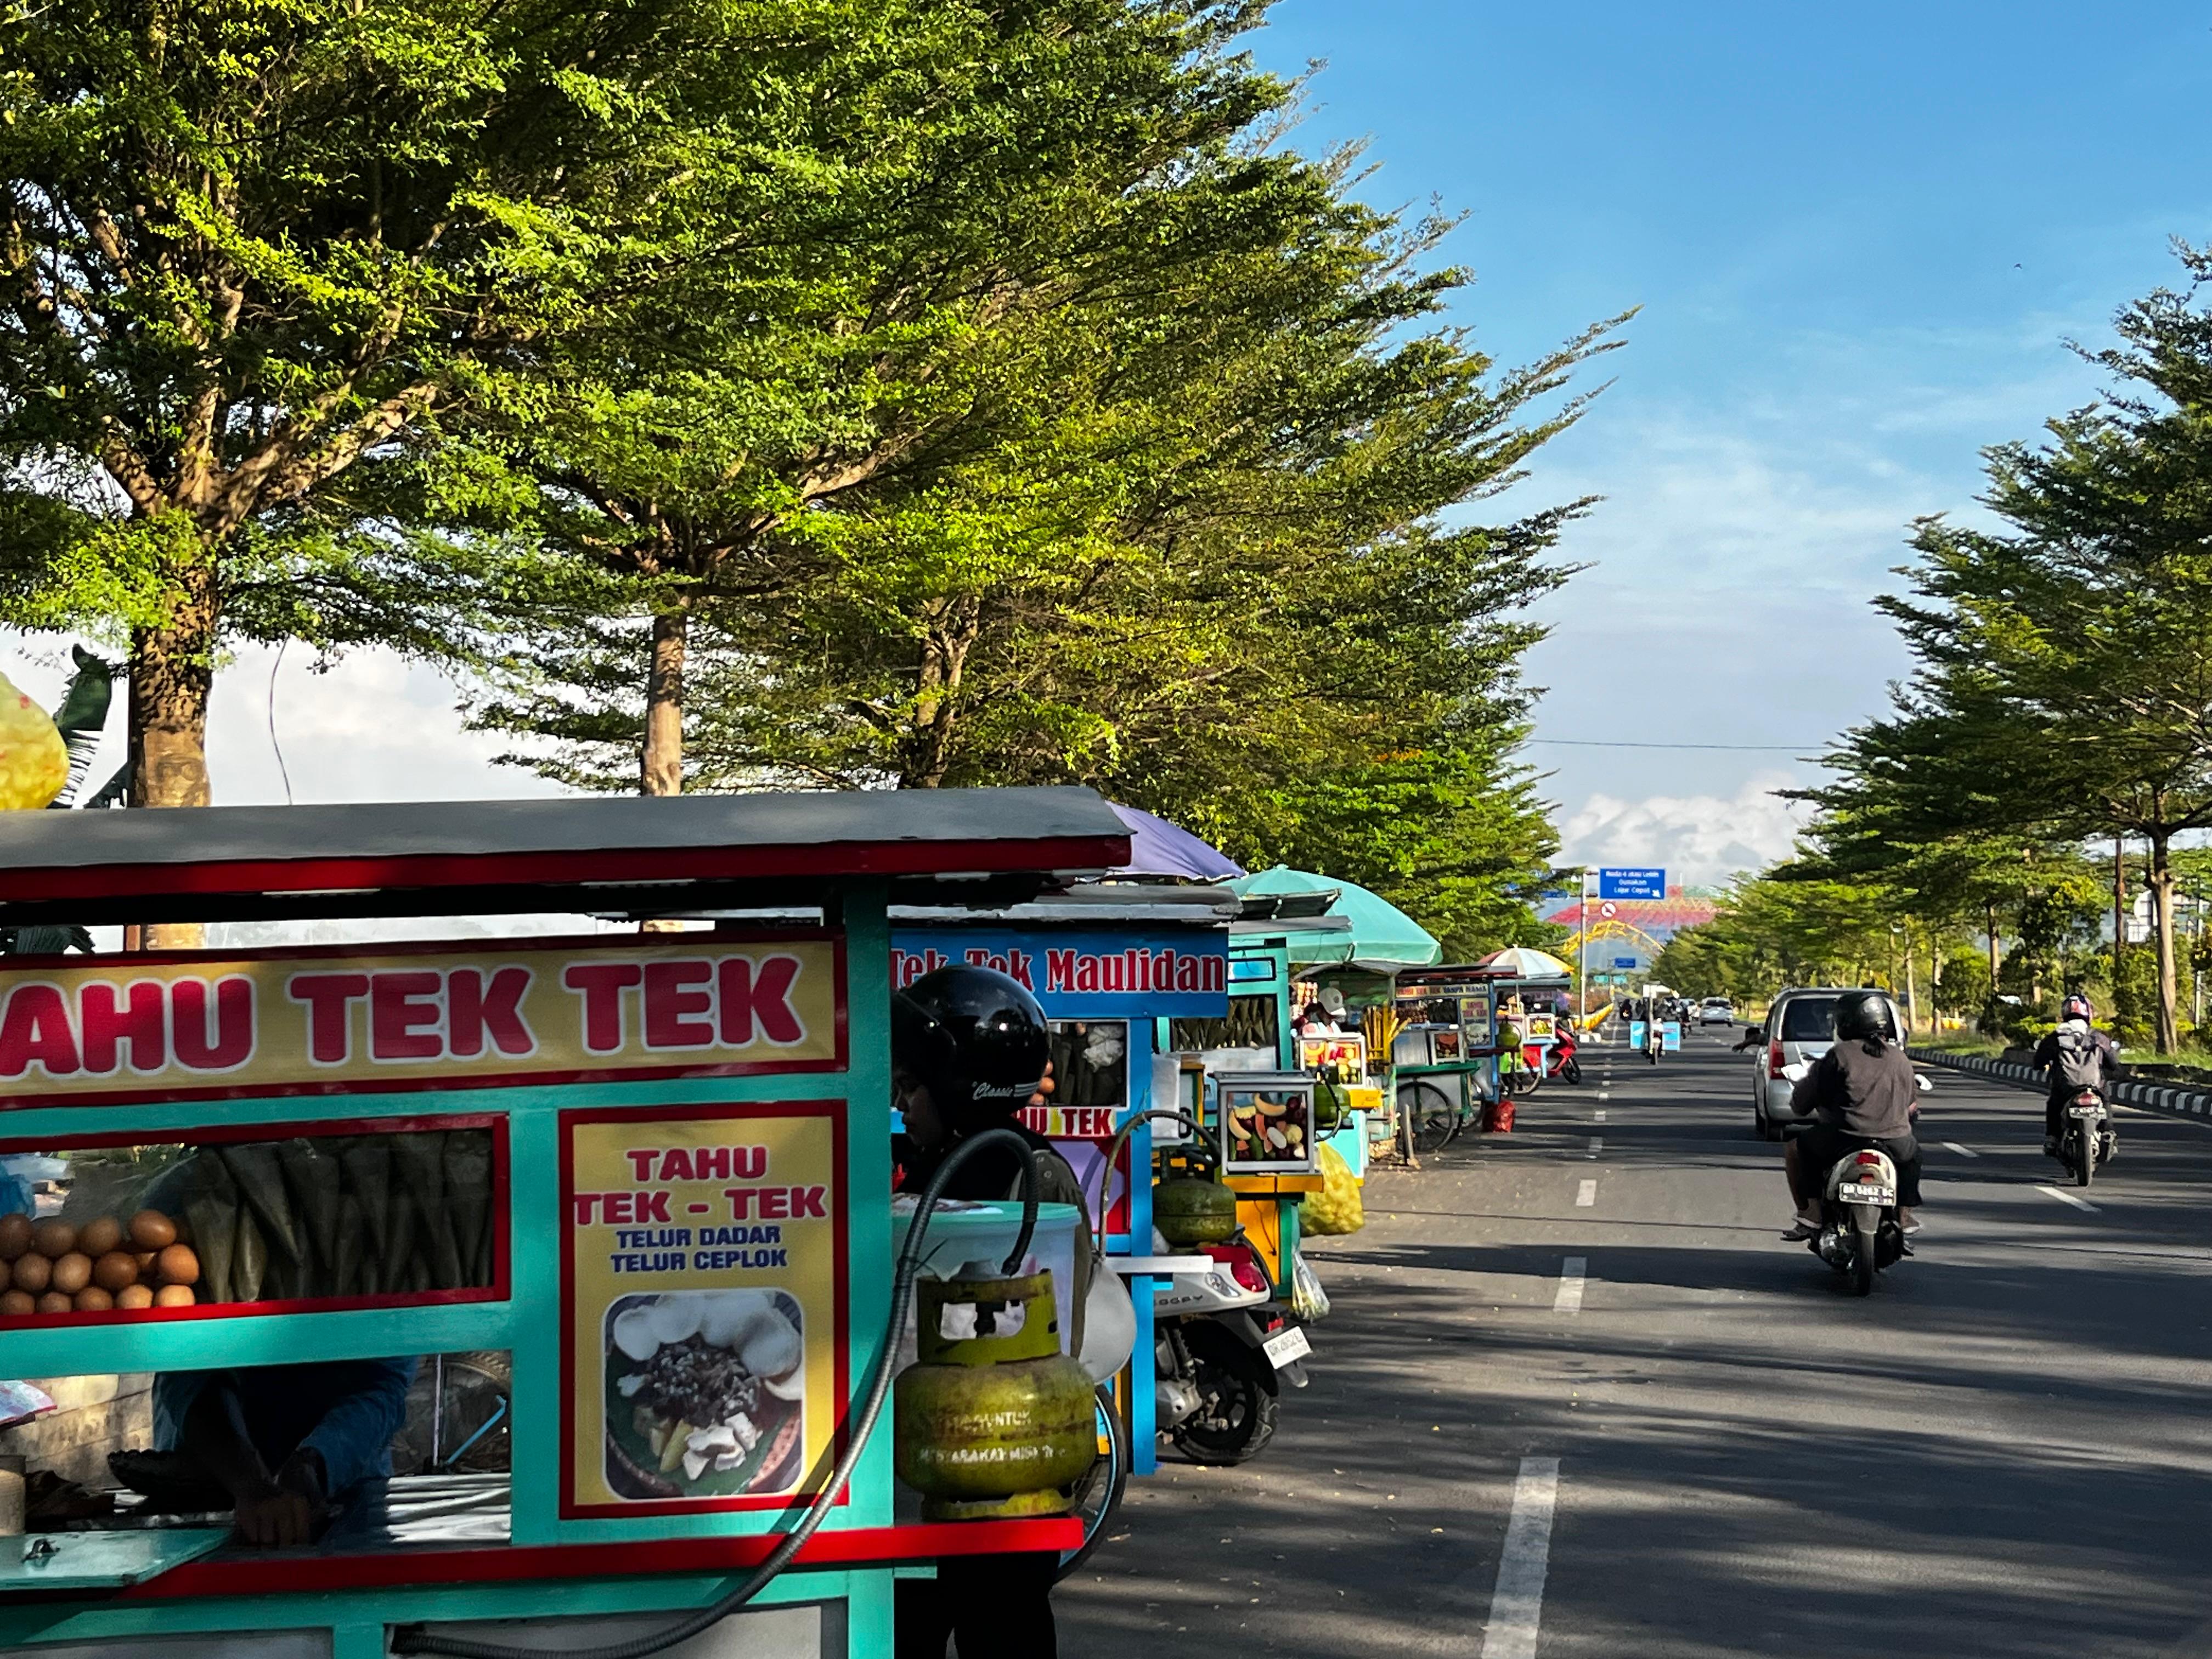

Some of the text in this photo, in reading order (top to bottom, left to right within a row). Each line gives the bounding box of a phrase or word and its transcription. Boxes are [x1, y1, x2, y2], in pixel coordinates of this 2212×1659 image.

[1046, 948, 1227, 994] Maulidan
[287, 967, 538, 1066] TEK
[562, 953, 808, 1054] TEK
[972, 1082, 1013, 1101] Classic
[1062, 1108, 1112, 1135] TEK
[627, 1145, 768, 1182] TAHU
[575, 1190, 671, 1225] TEK
[725, 1186, 827, 1221] TEK
[616, 1225, 781, 1250] TELUR DADAR
[611, 1249, 788, 1273] TELUR CEPLOK
